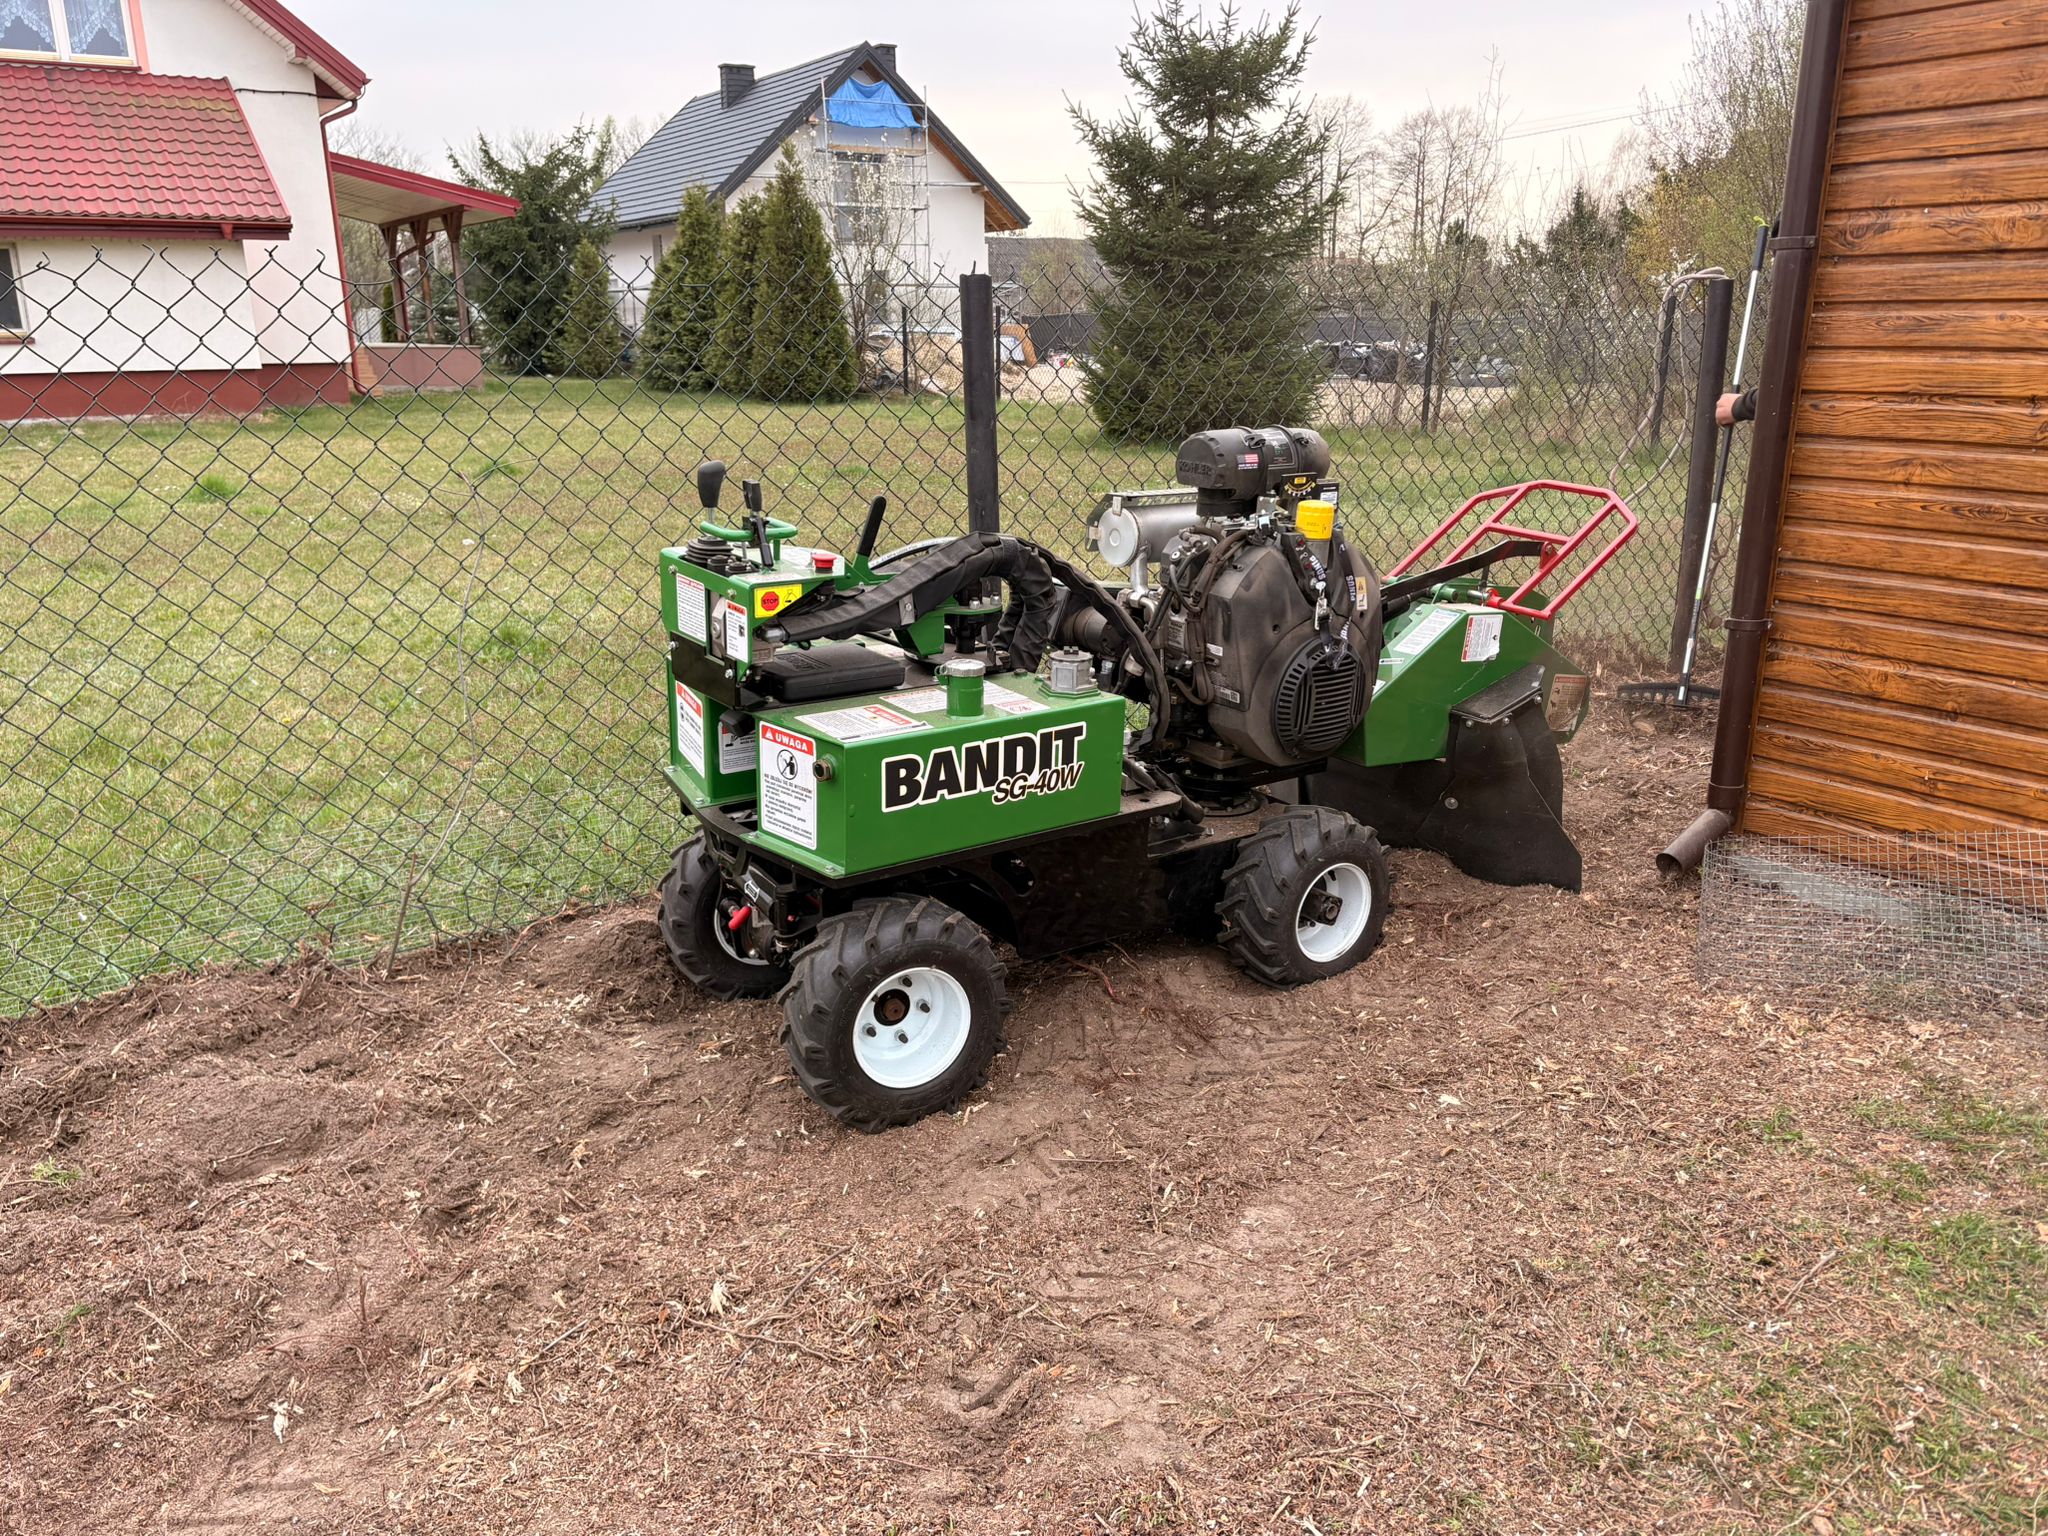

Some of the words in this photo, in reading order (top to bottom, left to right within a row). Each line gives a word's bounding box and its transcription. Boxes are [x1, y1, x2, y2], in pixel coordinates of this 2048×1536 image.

[761, 598, 779, 606] STOP
[775, 732, 809, 752] UWAGA
[883, 724, 1086, 811] BANDIT
[992, 763, 1084, 803] SG-40W
